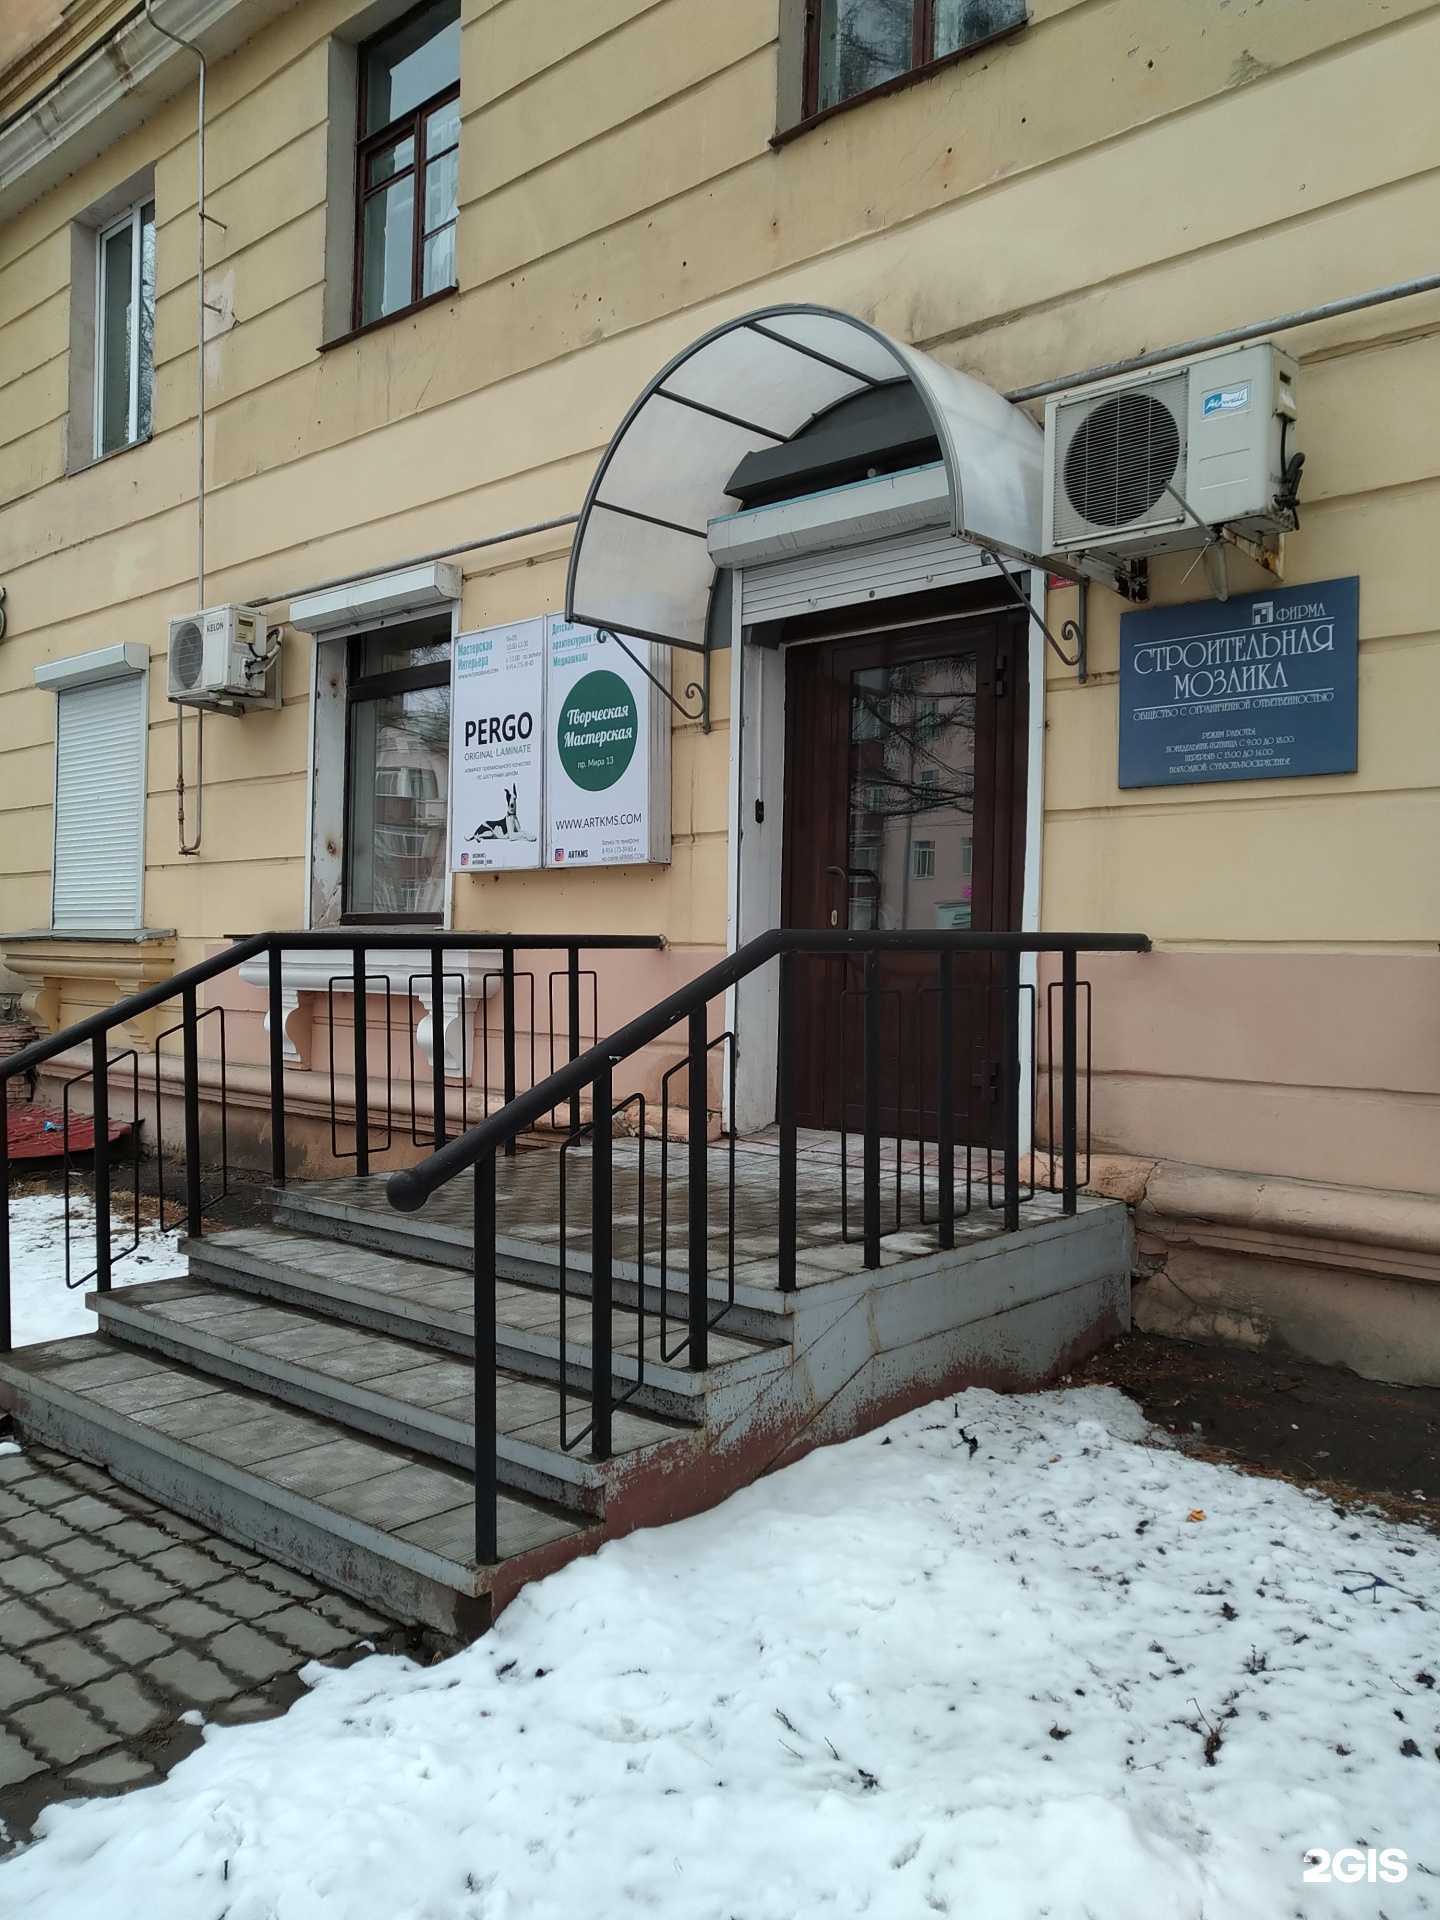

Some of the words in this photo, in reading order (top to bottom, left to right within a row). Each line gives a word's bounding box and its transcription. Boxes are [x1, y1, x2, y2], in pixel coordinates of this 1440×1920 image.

[1276, 603, 1327, 621] ФИРМА
[206, 622, 224, 633] KELON
[457, 640, 493, 657] Мастерская
[1134, 624, 1335, 675] СТРОИТЕЛЬНАЯ
[1174, 661, 1288, 700] МОЗАИКА
[566, 704, 629, 728] Творческая
[1133, 708, 1178, 721] ОБЩЕСТВО
[1180, 706, 1187, 716] С
[464, 711, 533, 747] PERGO
[564, 727, 633, 749] Мастерская
[464, 750, 494, 761] ORIGINAL
[495, 743, 532, 757] LAMINATE
[587, 758, 605, 768] Мира
[606, 755, 614, 766] 13
[555, 813, 642, 831] WWW.ARTKMS.COM
[568, 849, 589, 859] ARTKMS
